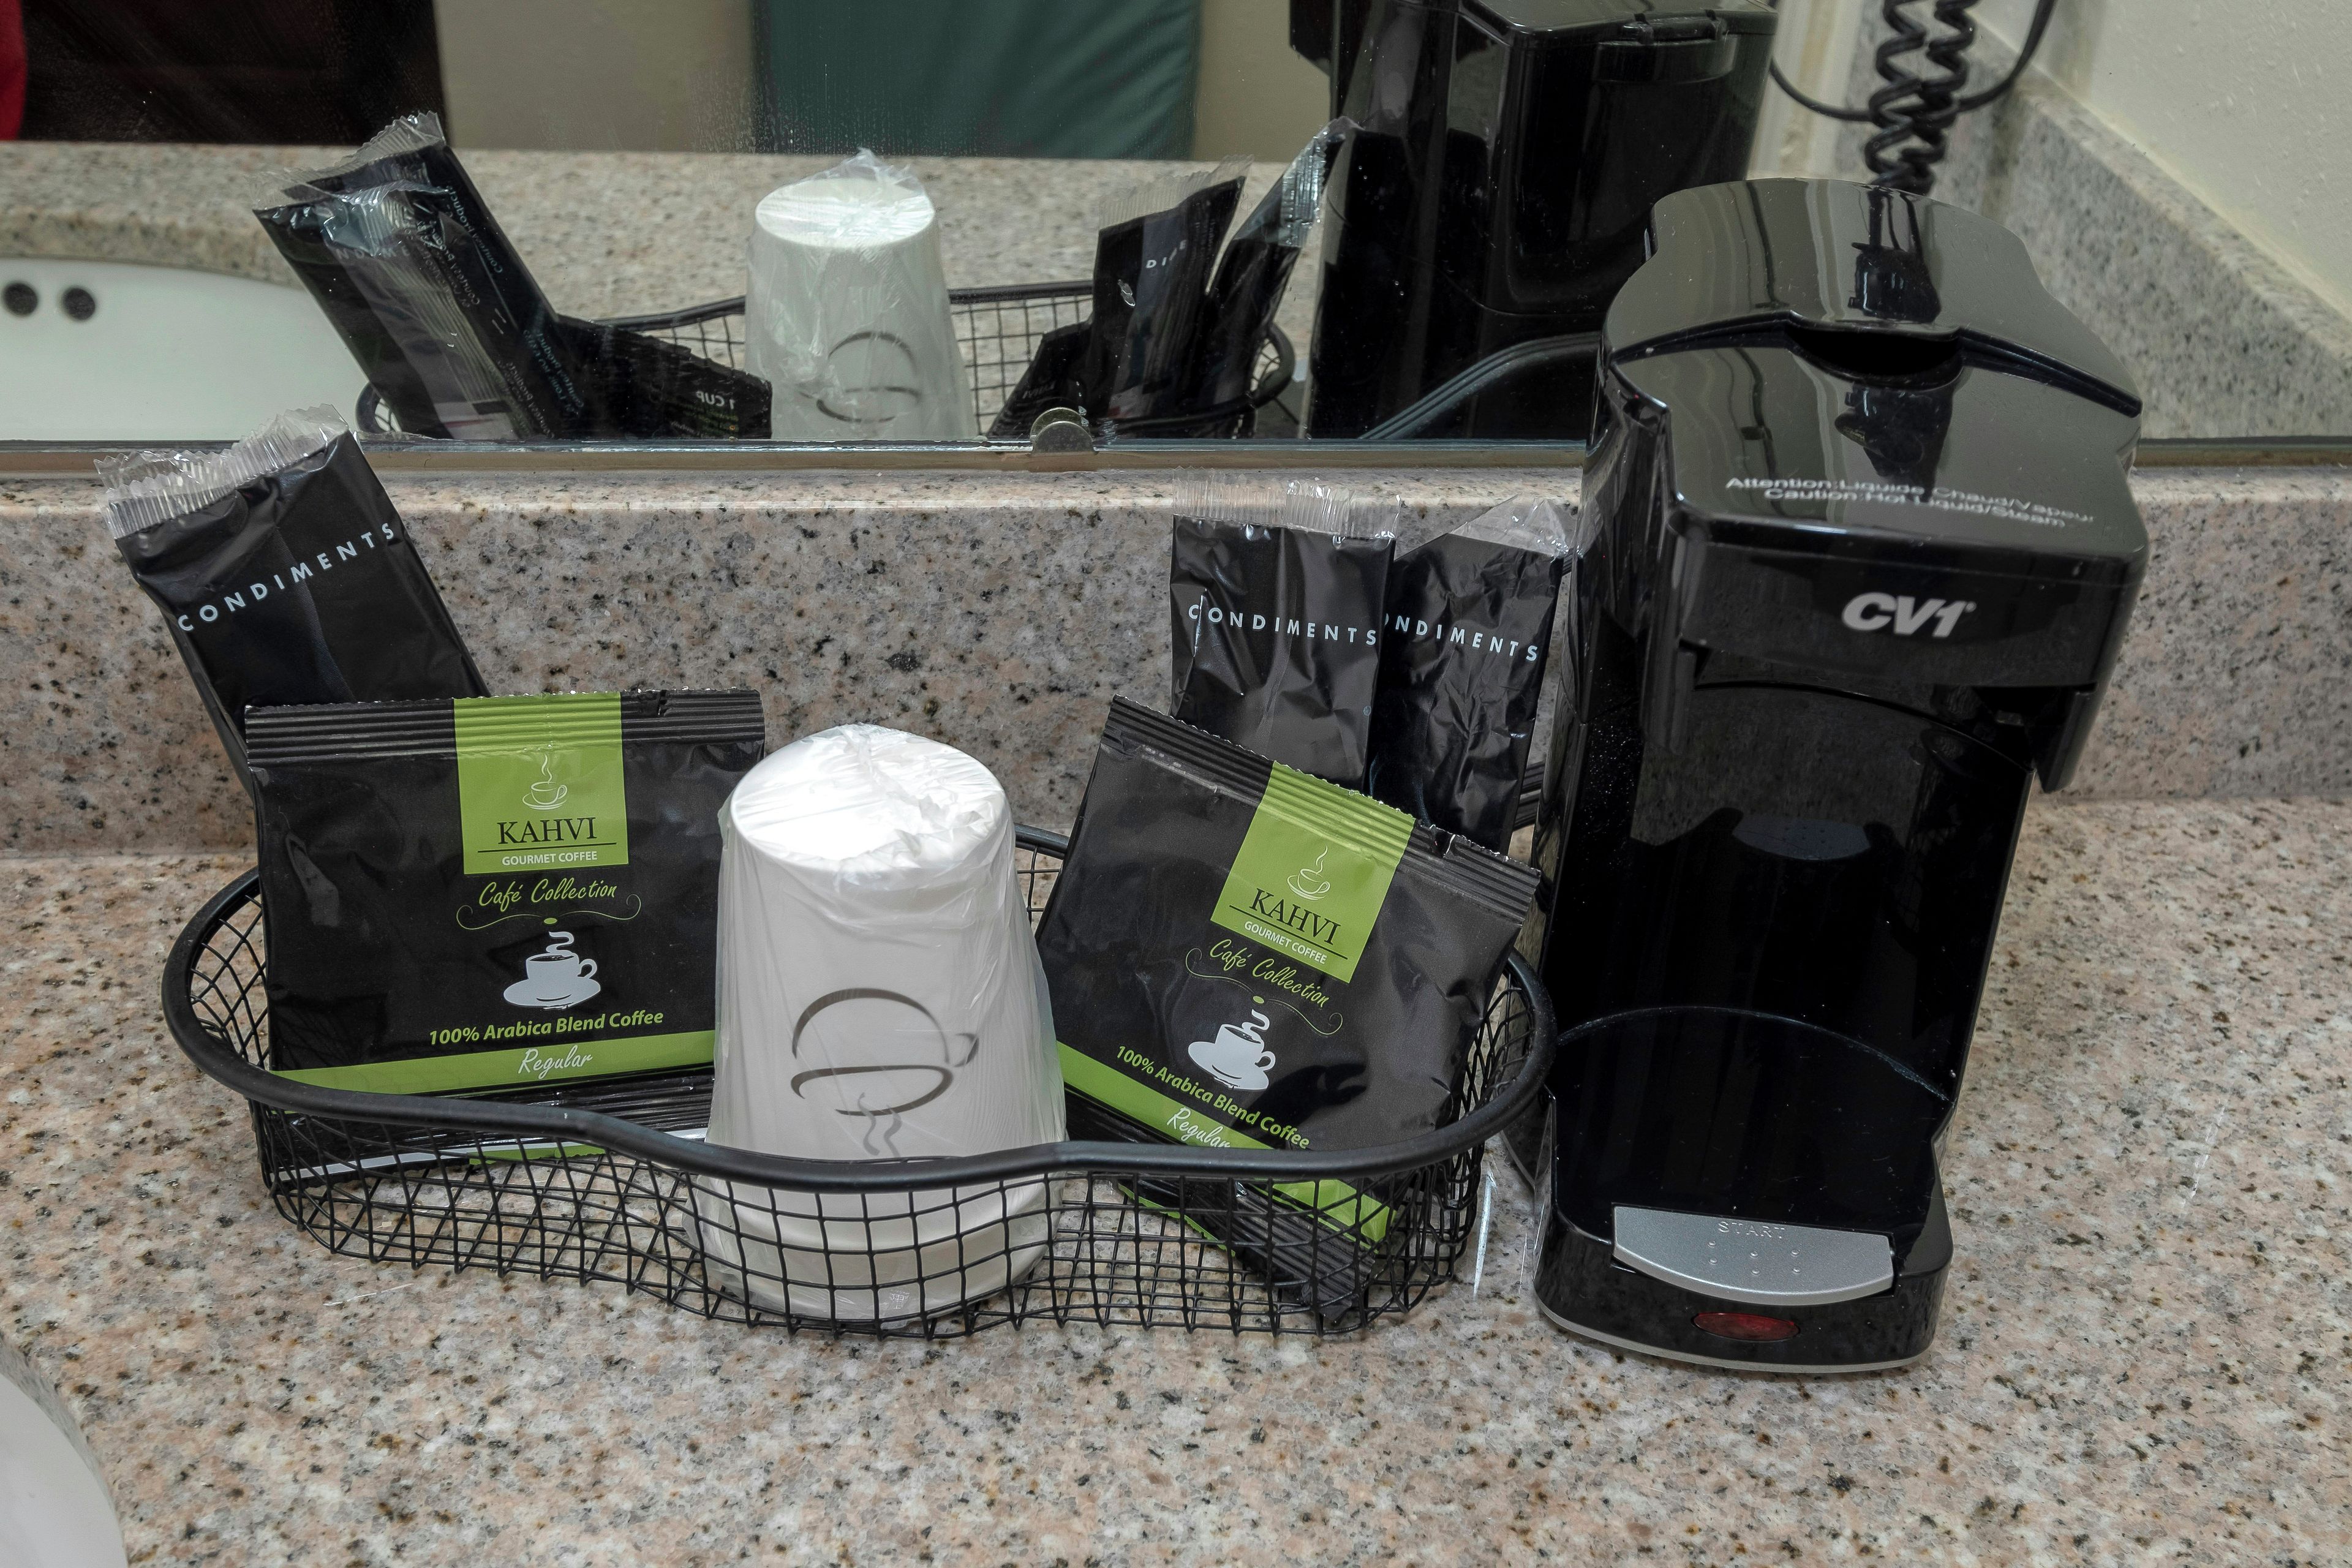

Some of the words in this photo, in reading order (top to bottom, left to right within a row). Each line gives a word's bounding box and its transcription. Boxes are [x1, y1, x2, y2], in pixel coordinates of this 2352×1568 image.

[178, 522, 394, 631] CONDIMENTS
[1188, 604, 1376, 646] CONDIMENTS
[1385, 613, 1538, 662] NDIMENTS
[497, 817, 597, 845] KAHVI
[502, 853, 556, 866] GOURMET
[558, 851, 598, 862] COFFEE
[479, 881, 522, 912] Café
[531, 877, 617, 903] Collection
[1249, 888, 1341, 946] KAHVI
[1244, 921, 1292, 948] GOURMET
[1292, 942, 1328, 965] COFFEE
[1210, 938, 1253, 970] Café
[1253, 959, 1330, 1008] Collection
[429, 1027, 480, 1045] 100%
[483, 1020, 552, 1040] Arabica
[556, 1013, 606, 1033] Blend
[609, 1009, 664, 1027] Coffee
[518, 1044, 593, 1079] Regular
[1117, 1046, 1155, 1074] 100%
[1155, 1066, 1213, 1103] Arabica
[1213, 1093, 1261, 1125] Blend
[1260, 1117, 1310, 1149] Coffee
[1167, 1106, 1231, 1148] Regular
[1718, 1221, 1785, 1239] START
